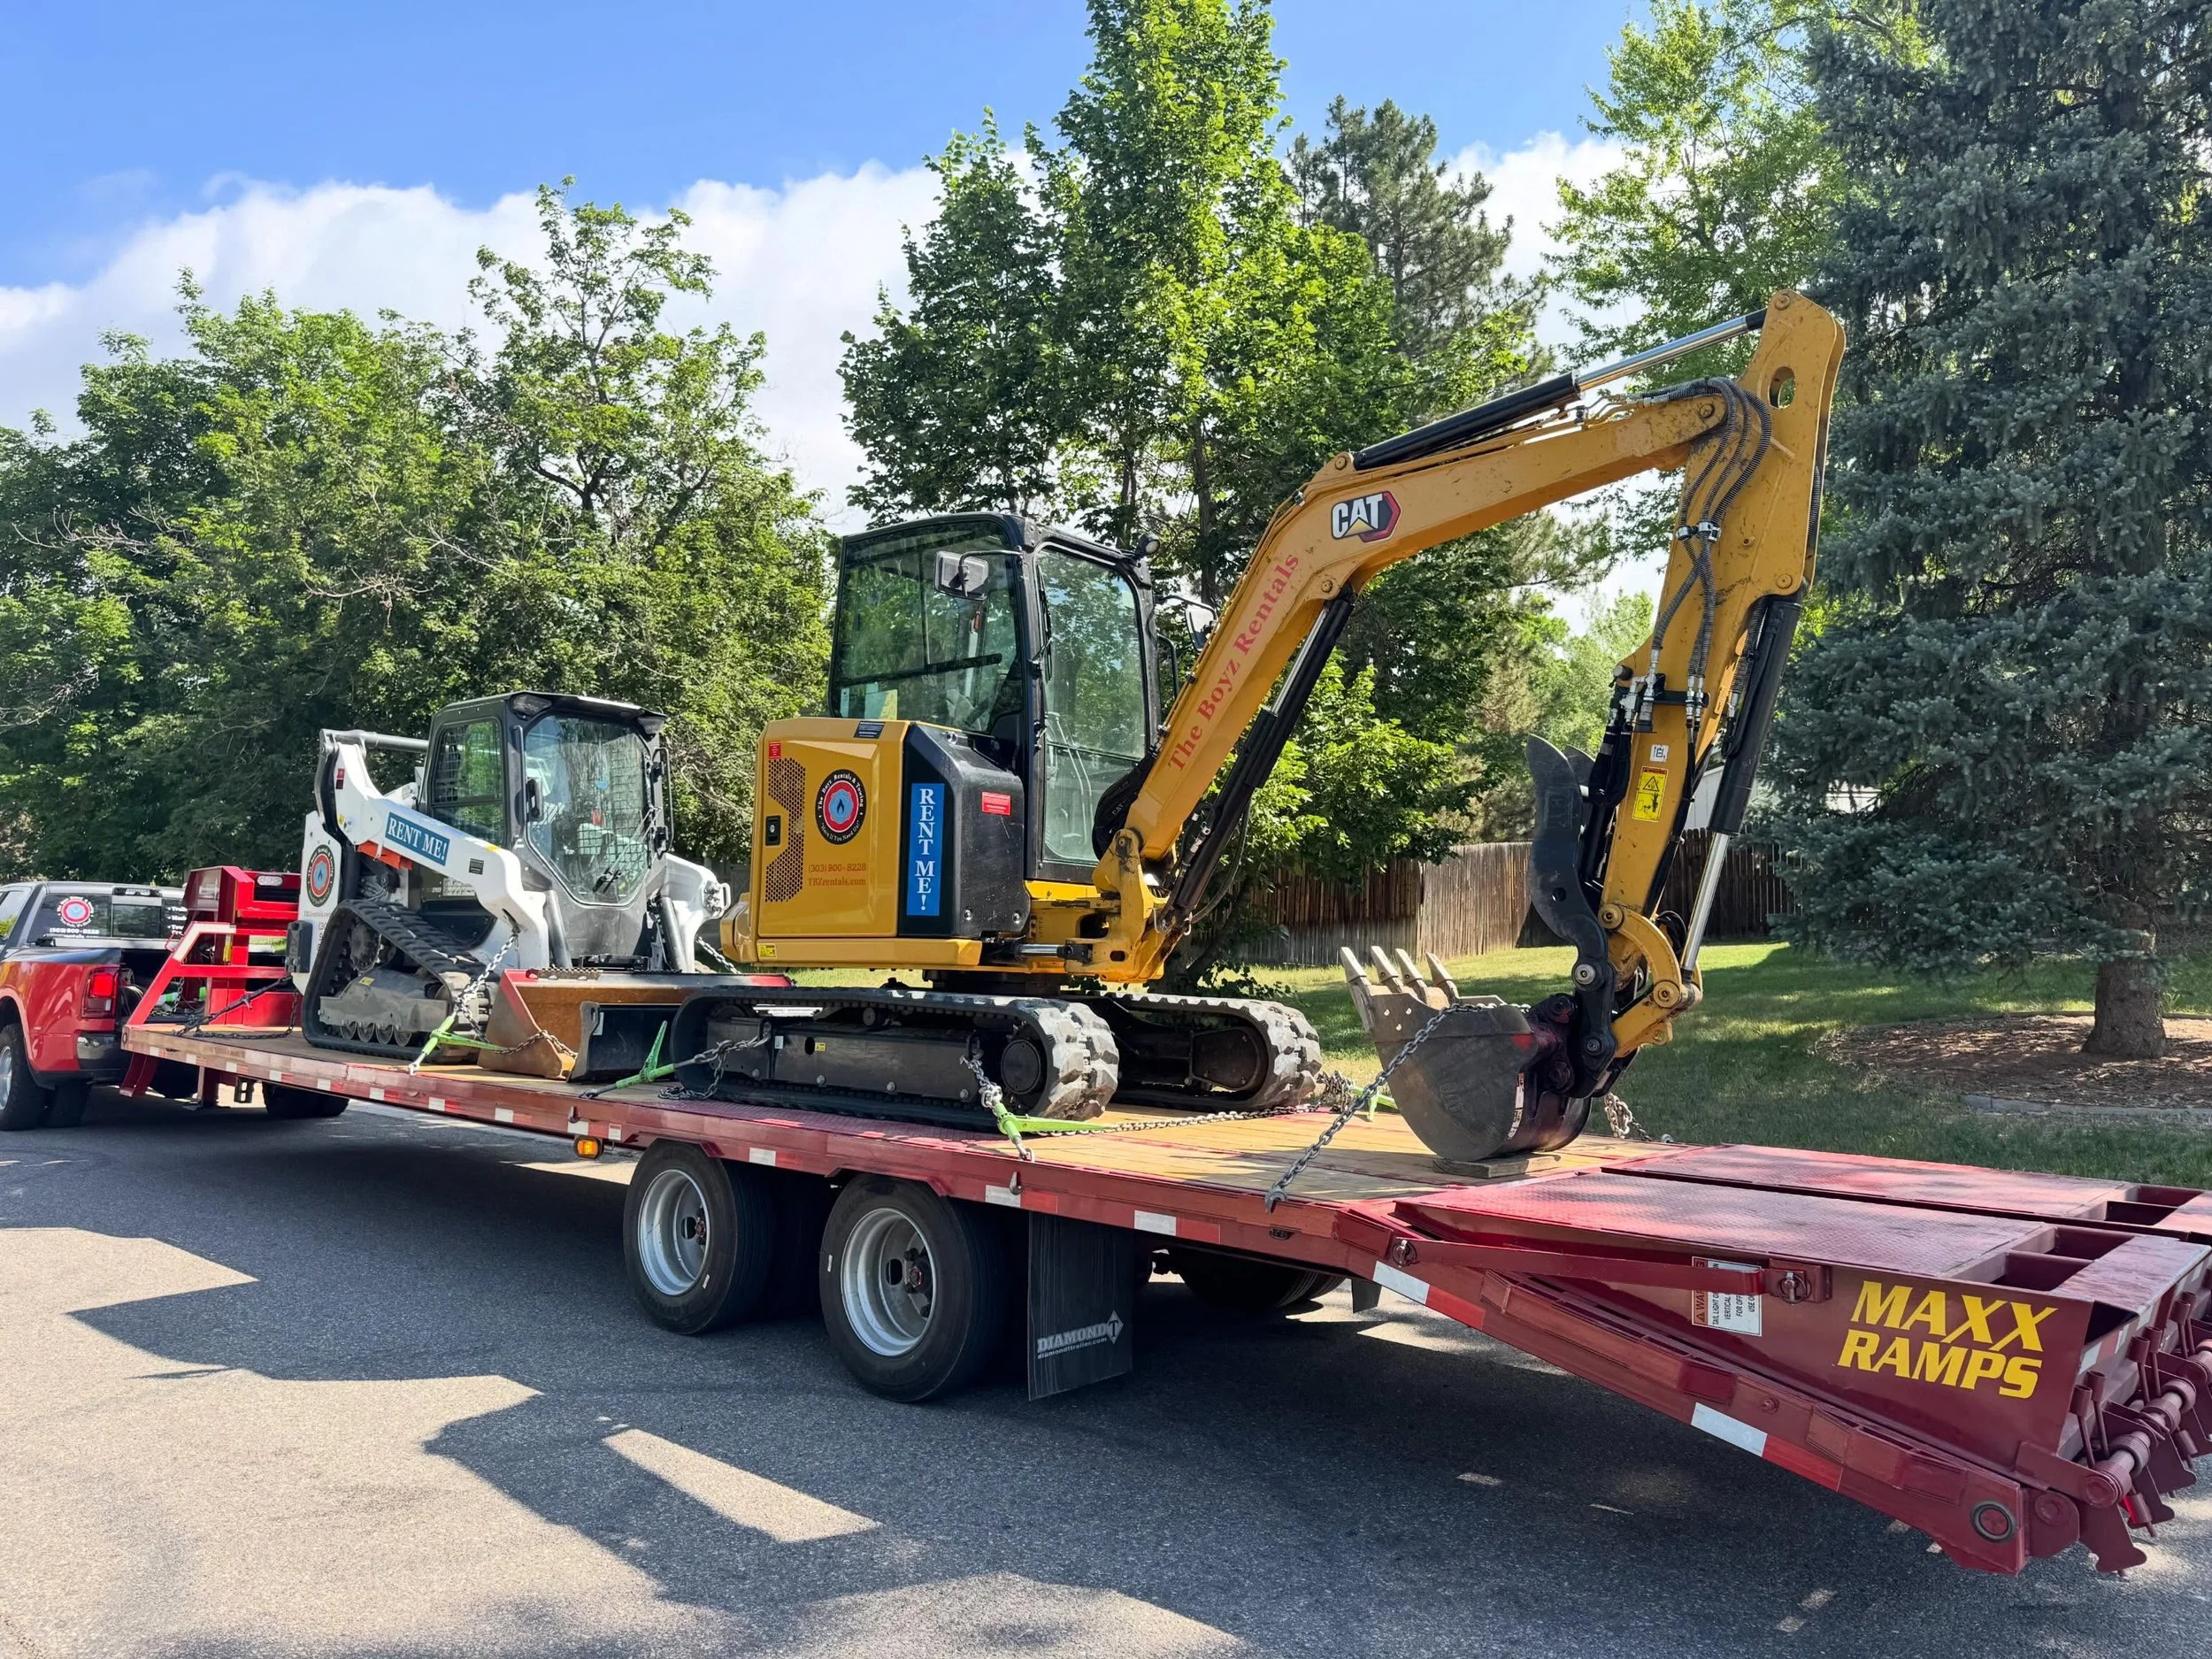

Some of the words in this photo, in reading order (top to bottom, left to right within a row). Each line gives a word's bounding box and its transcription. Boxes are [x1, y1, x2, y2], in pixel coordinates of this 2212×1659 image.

[1332, 493, 1383, 539] CAT
[1168, 726, 1203, 772] The
[1196, 658, 1240, 722] Boyz
[1233, 554, 1300, 656] Rentals
[388, 817, 422, 848] RENT
[422, 833, 447, 861] ME!
[918, 788, 936, 856] RENT
[914, 860, 935, 910] ME!
[1037, 1323, 1108, 1354] DIAMOND
[1850, 1280, 2059, 1352] MAXX
[1037, 1337, 1108, 1360] diamondttrailer.com
[1837, 1328, 2043, 1399] RAMPS
